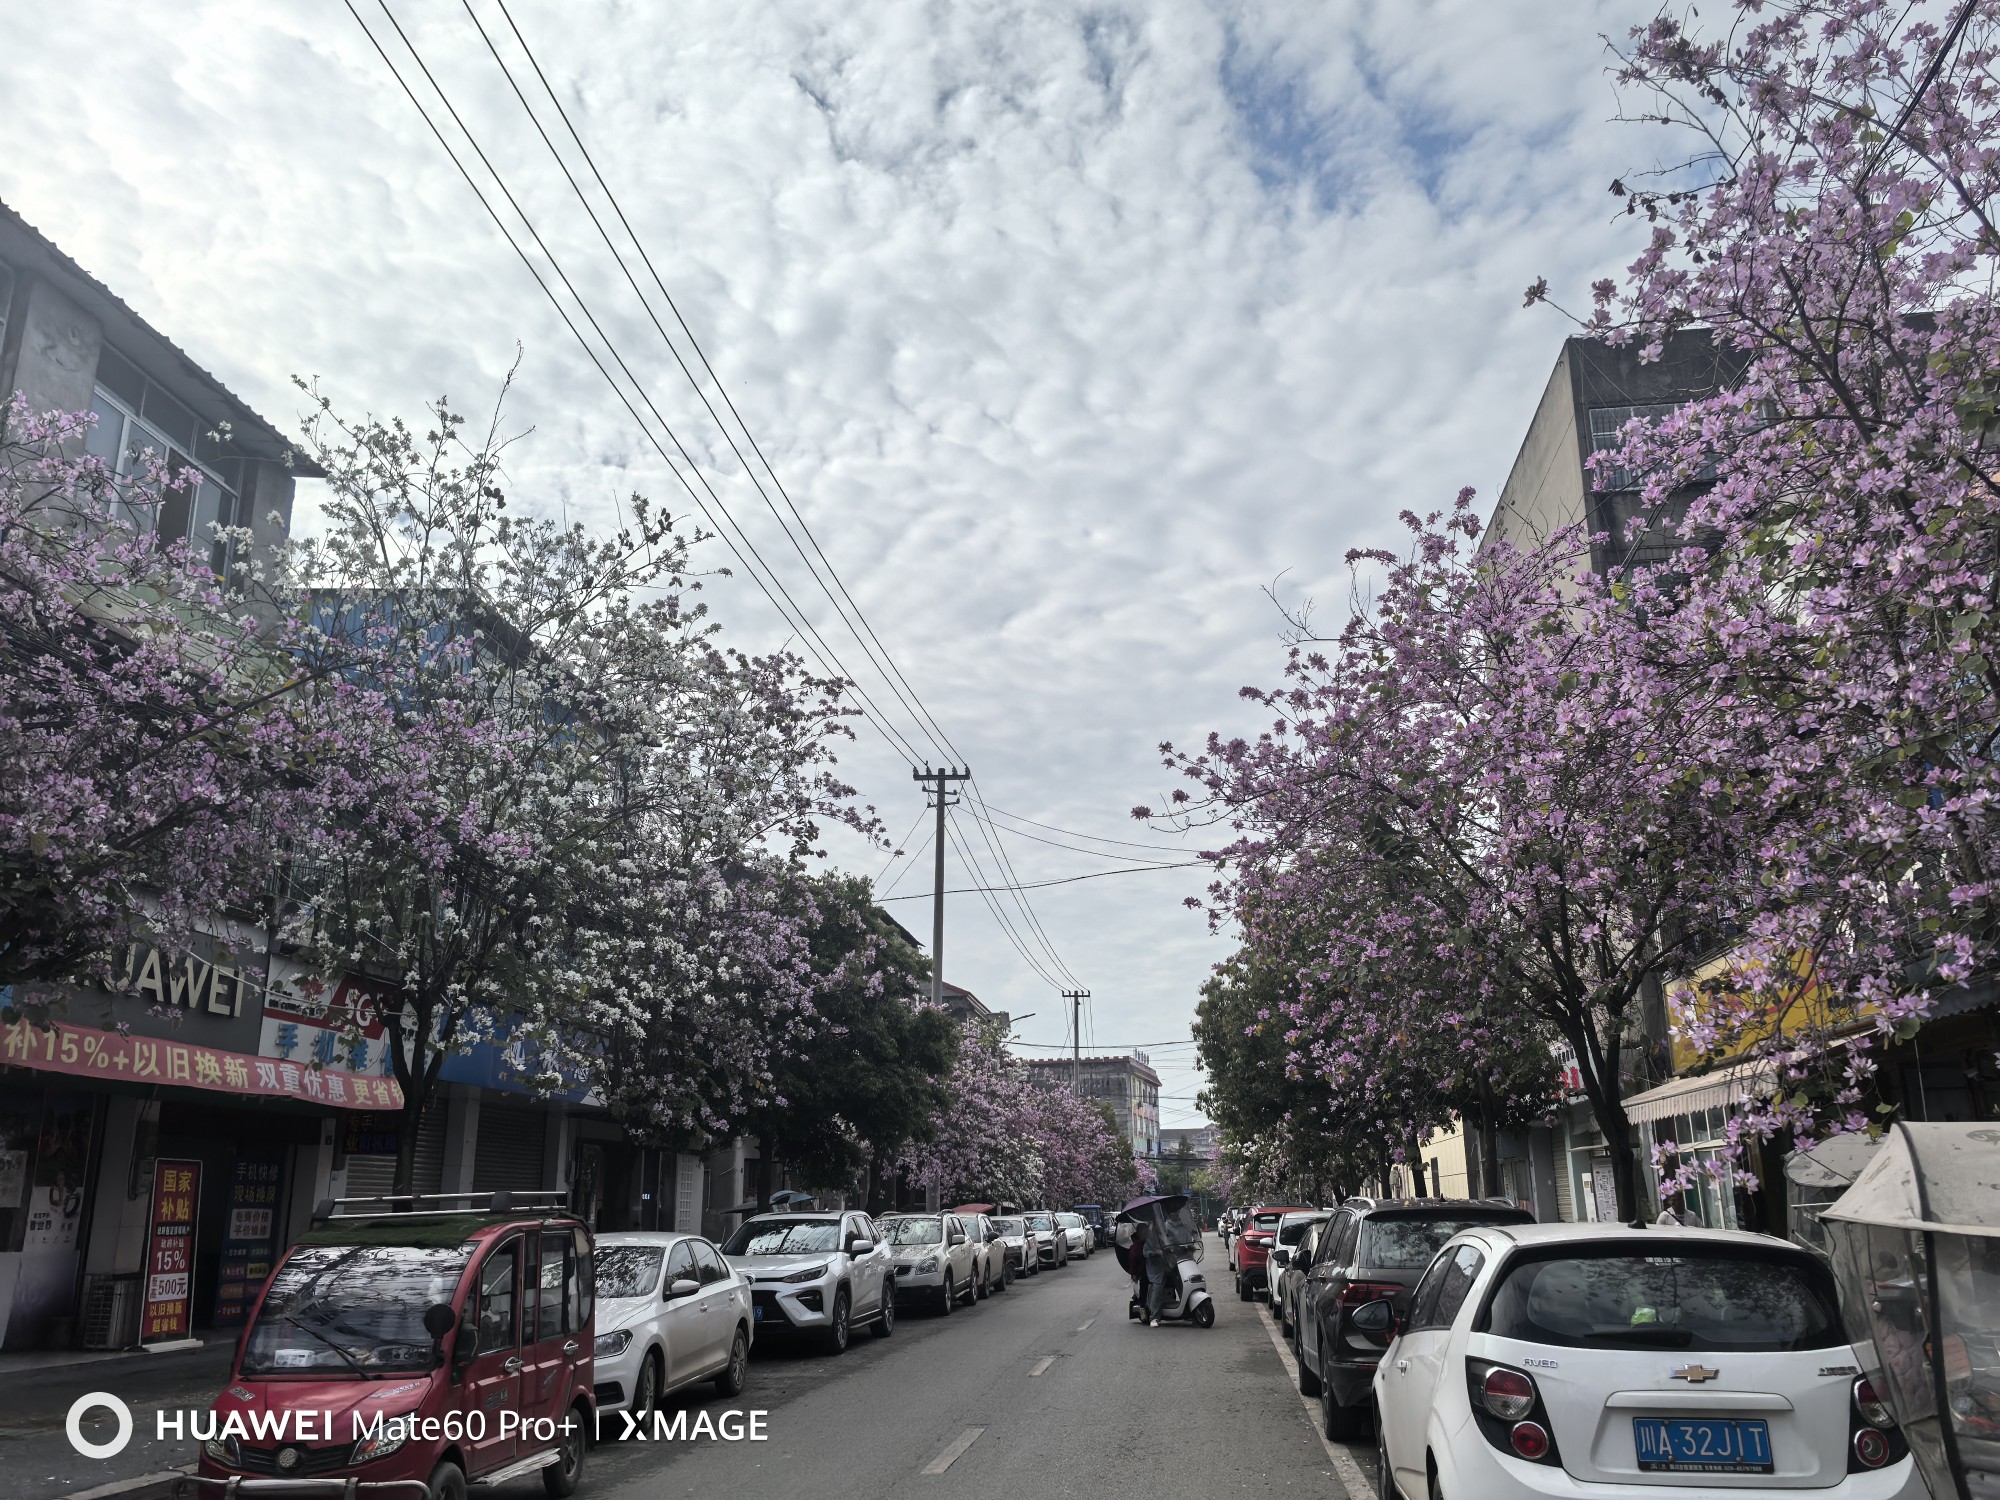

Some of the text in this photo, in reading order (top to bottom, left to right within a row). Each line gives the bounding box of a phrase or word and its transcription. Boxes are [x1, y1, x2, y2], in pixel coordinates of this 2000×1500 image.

[255, 1062, 347, 1102] 双重优惠
[163, 1169, 193, 1192] 国家
[161, 1196, 190, 1221] 补贴
[156, 1249, 186, 1271] 15%
[158, 1278, 187, 1296] 500元
[149, 1301, 183, 1317] 以旧换新
[1523, 1358, 1558, 1368] AVEO
